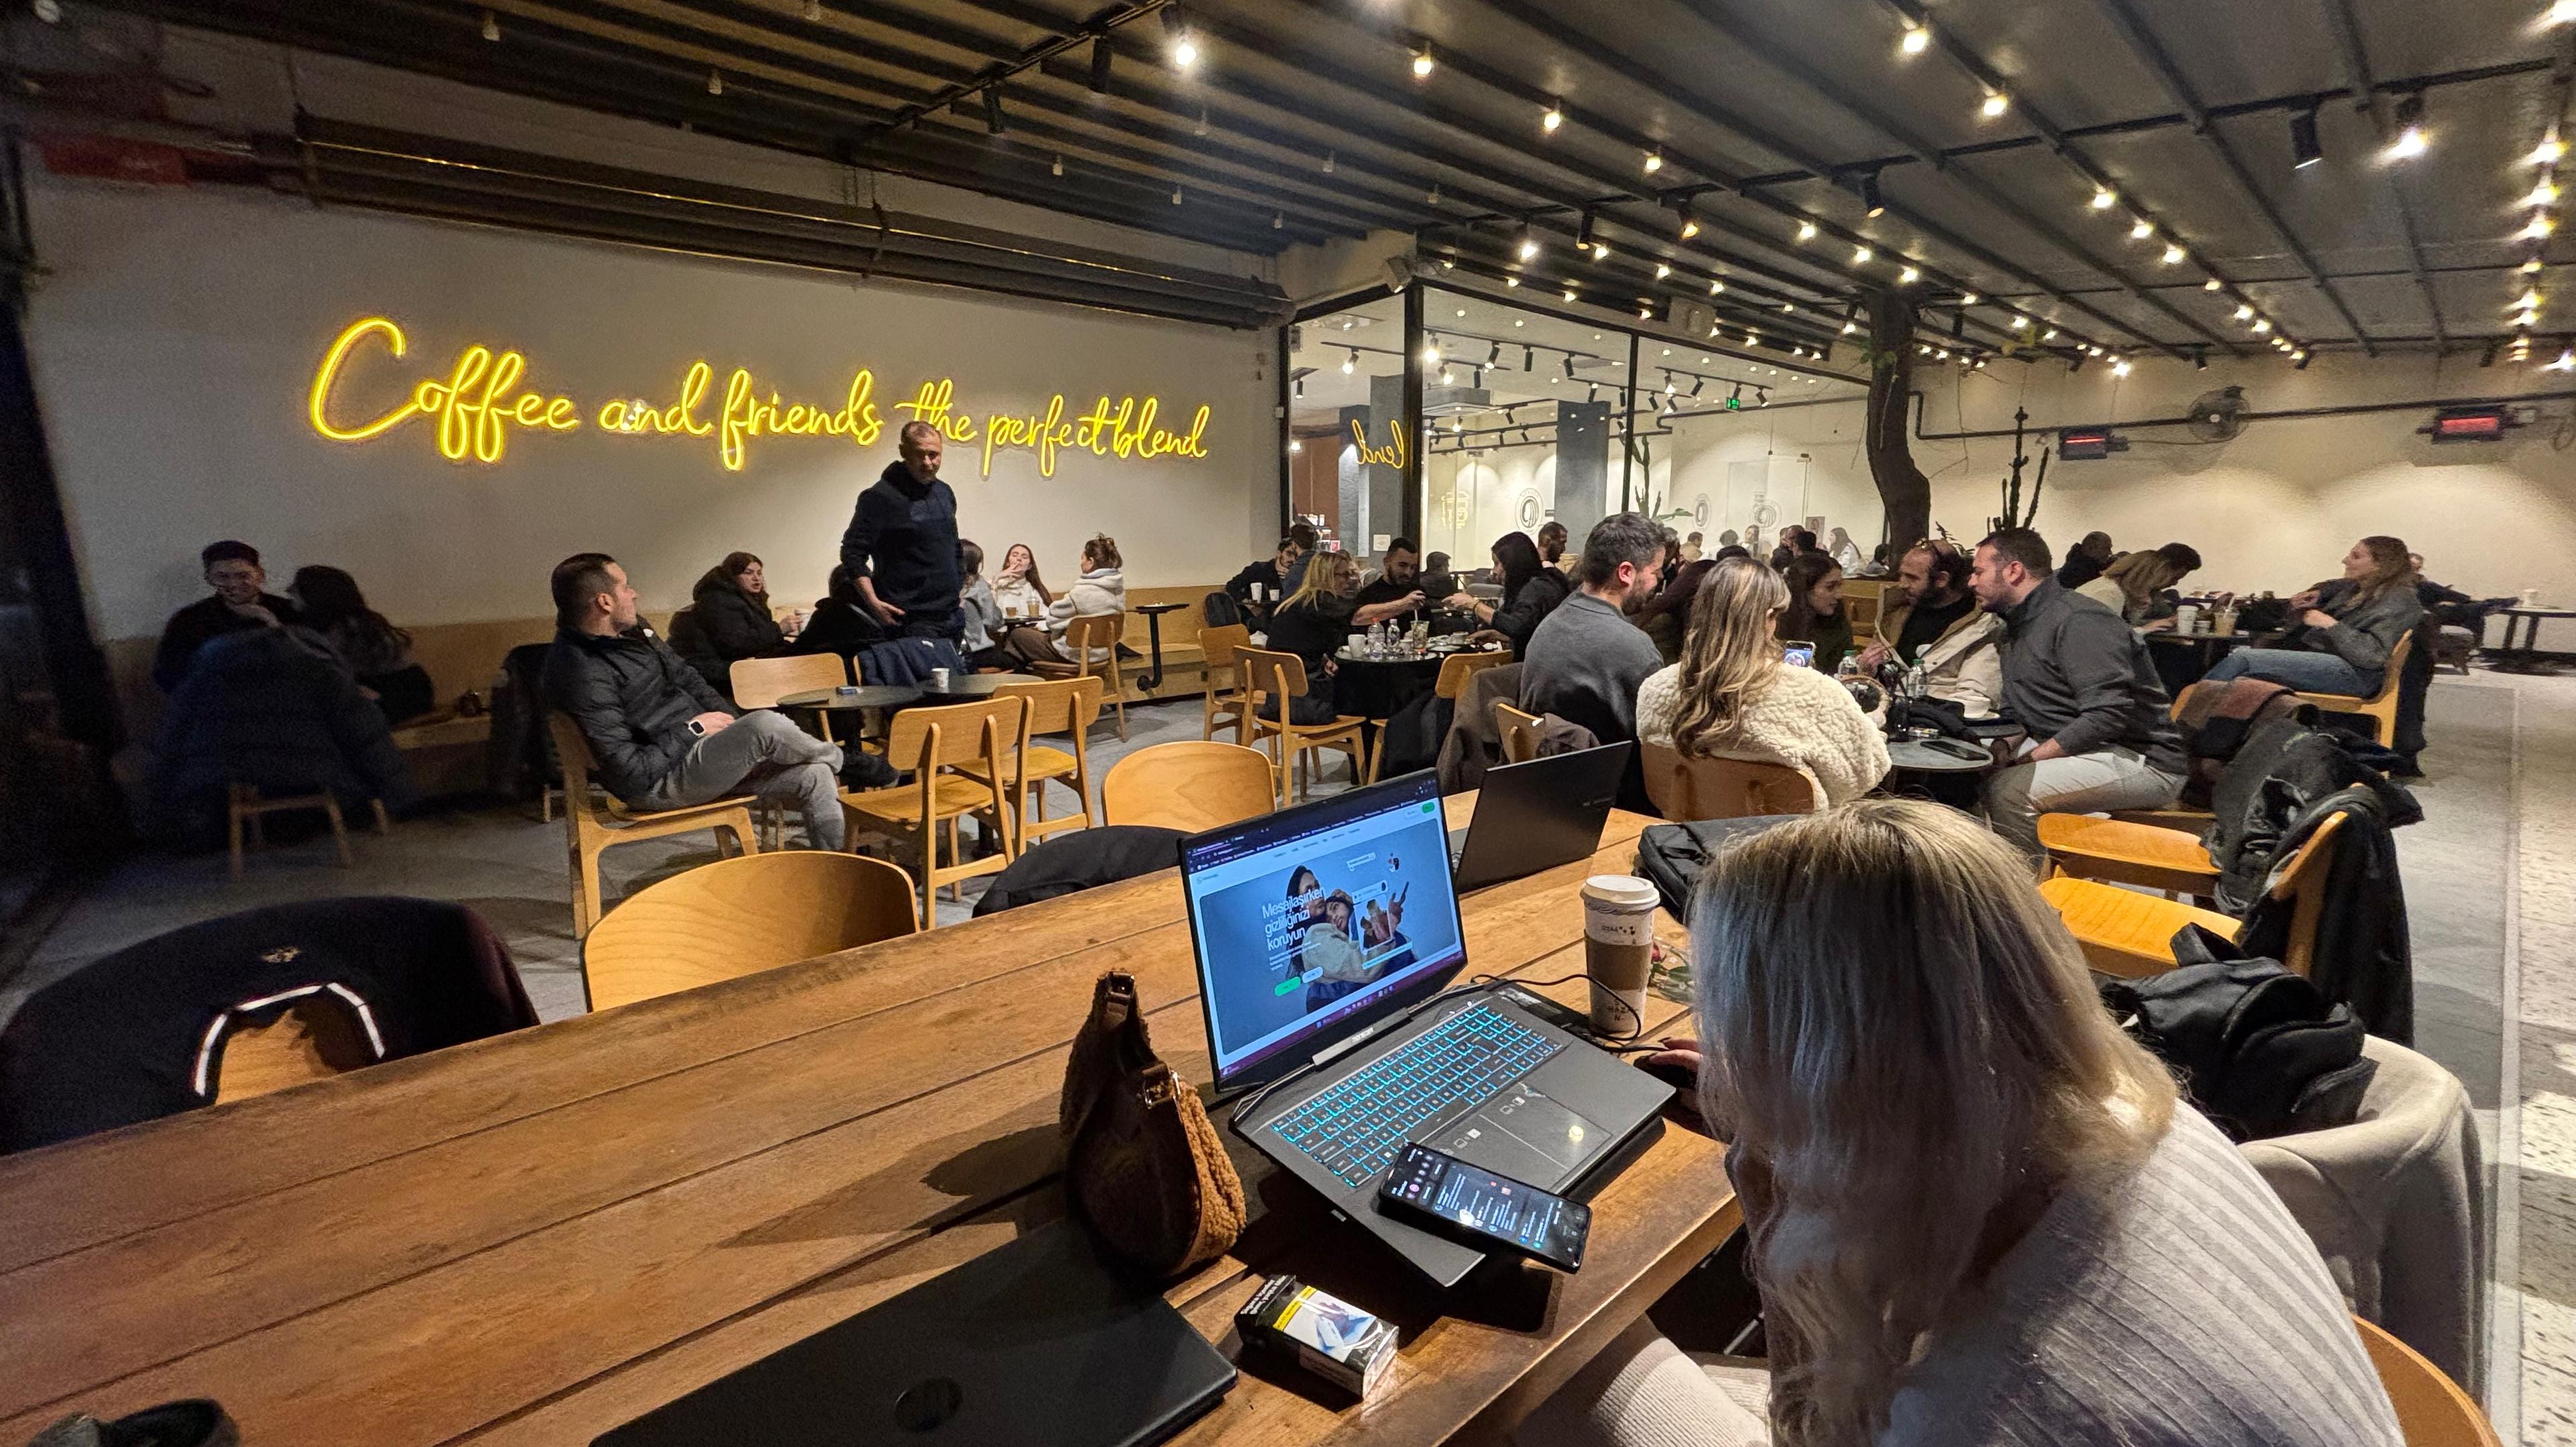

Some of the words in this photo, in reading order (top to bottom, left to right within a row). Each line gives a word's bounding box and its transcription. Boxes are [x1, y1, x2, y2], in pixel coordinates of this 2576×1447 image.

[310, 318, 581, 462] Coffee
[598, 362, 715, 436] and
[721, 369, 885, 471] friends
[894, 378, 977, 442] the
[981, 394, 1118, 477] perfect
[1113, 396, 1210, 459] blend
[1267, 926, 1306, 951] koruyun
